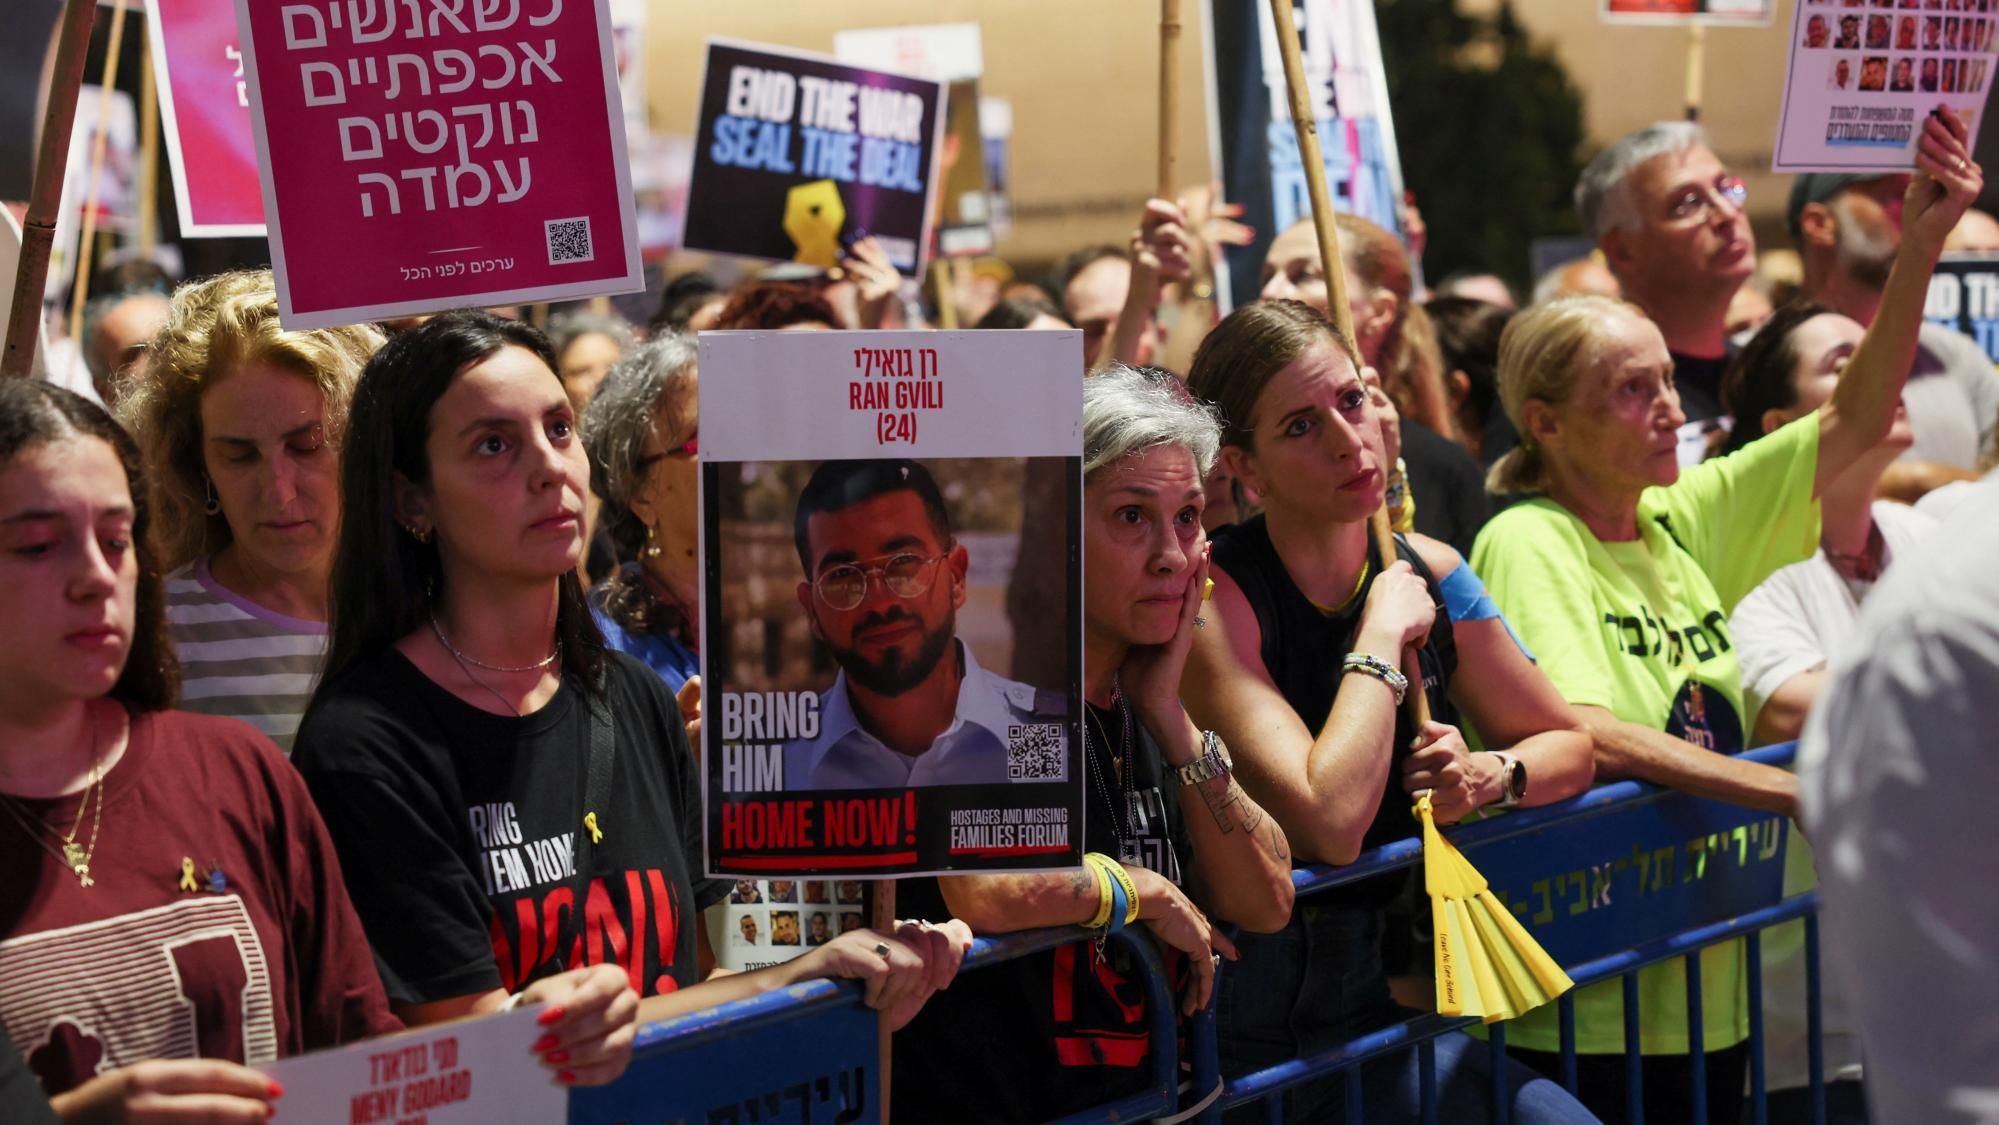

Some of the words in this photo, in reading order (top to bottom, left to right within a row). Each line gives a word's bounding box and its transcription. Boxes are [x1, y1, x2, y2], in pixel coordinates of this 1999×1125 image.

[281, 0, 564, 51] כשאנשים
[300, 39, 564, 107] אכפתיים
[727, 65, 797, 124] END
[799, 76, 859, 133] THE
[859, 86, 925, 144] WAR
[338, 100, 539, 170] נוקטים
[710, 114, 796, 175] SEAL
[801, 126, 860, 182] THE
[859, 136, 923, 193] DEAL
[358, 156, 532, 217] עמדה
[400, 266, 432, 281] הכל
[435, 261, 465, 277] לפני
[470, 257, 515, 273] ערכים
[1963, 272, 1999, 320] TH
[854, 347, 914, 378] גואילי
[919, 347, 938, 380] רן
[849, 381, 889, 410] RAN
[895, 380, 944, 410] GVILI
[877, 412, 918, 445] (24)
[722, 690, 821, 740] BRING
[722, 744, 784, 792] HIM
[468, 801, 523, 848] RING
[722, 801, 814, 850] HOME
[824, 790, 919, 848] NOW!
[951, 809, 1001, 826] HOSTAGES
[1002, 809, 1023, 824] AND
[1024, 807, 1068, 823] MISSING
[951, 825, 1016, 849] FAMILIES
[1018, 824, 1068, 847] FORUM
[480, 847, 532, 896] EM
[1683, 817, 1780, 884] עיריית
